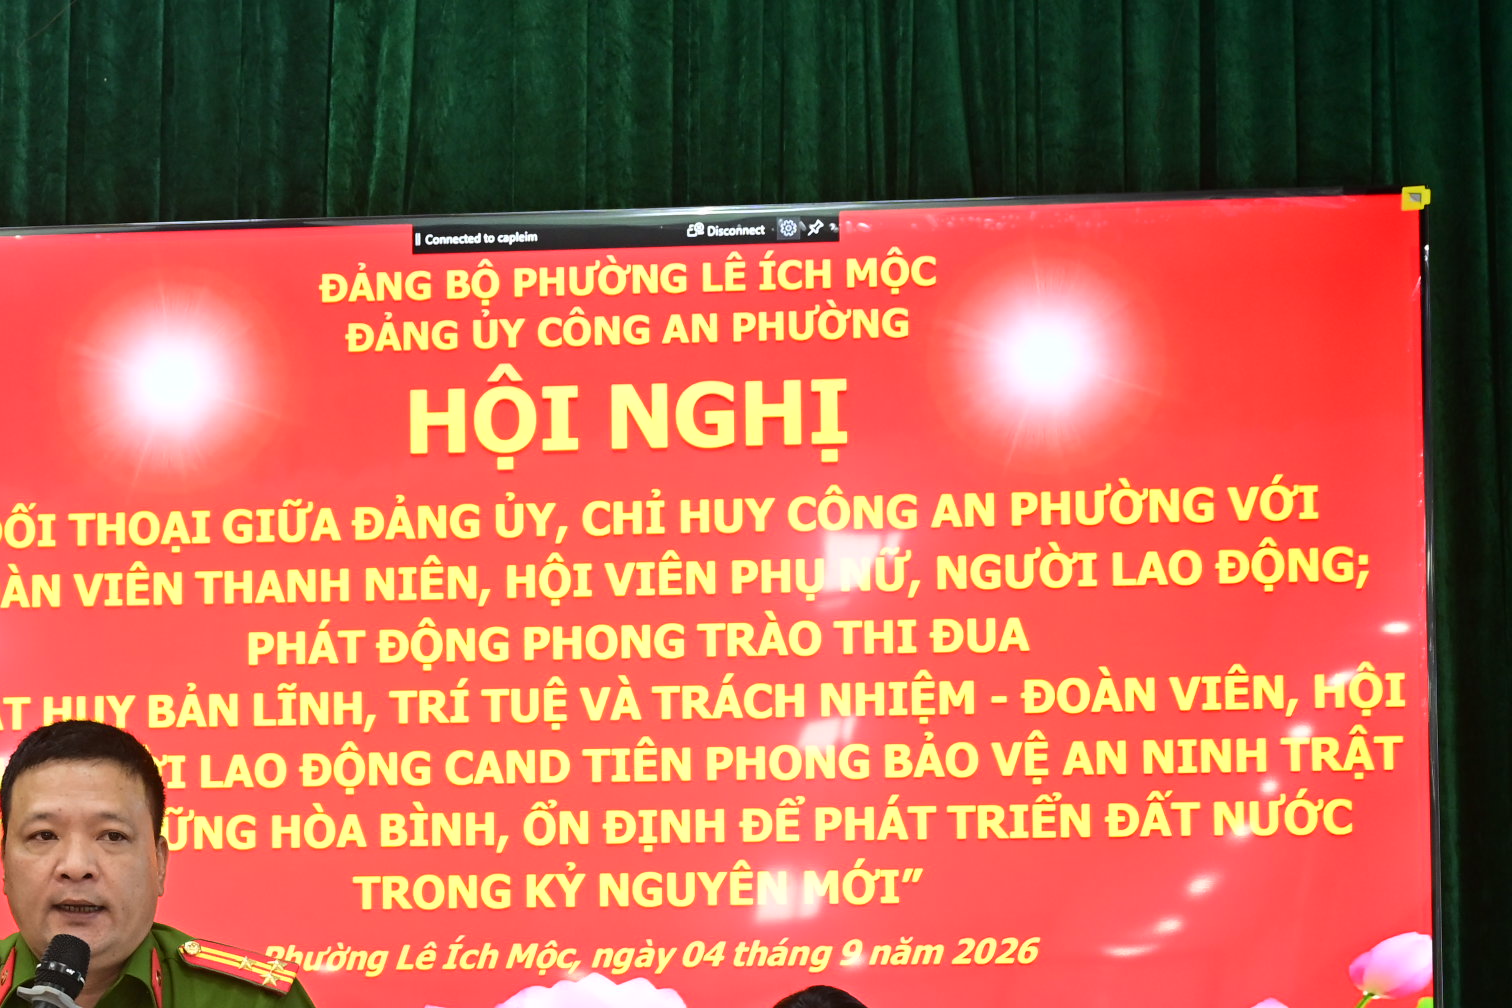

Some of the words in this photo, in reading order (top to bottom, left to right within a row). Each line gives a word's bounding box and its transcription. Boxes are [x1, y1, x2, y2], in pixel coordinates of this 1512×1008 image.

[424, 233, 482, 246] Connected
[483, 232, 496, 245] to
[496, 231, 539, 246] capleim
[706, 223, 766, 238] Disconnect
[319, 263, 431, 302] ĐẢNG
[447, 259, 499, 306] BỘ
[514, 255, 686, 297] PHƯỜNG
[703, 251, 746, 292] LÊ
[759, 250, 831, 290] ÍCH
[847, 247, 936, 294] MỘC
[345, 312, 458, 352] ĐẢNG
[473, 309, 525, 349] ỦY
[538, 307, 649, 347] CÔNG
[662, 313, 717, 343] AN
[733, 300, 908, 341] PHƯỜNG
[410, 364, 578, 470] HỘI
[611, 379, 847, 462] NGHỊ
[68, 511, 210, 553] THOẠI
[223, 499, 341, 543] GIỮA
[352, 495, 479, 540] ĐẢNG
[496, 492, 567, 544] ỦY,
[582, 489, 665, 536] CHỈ
[681, 498, 775, 533] HUY
[788, 485, 917, 531] CÔNG
[931, 493, 994, 528] AN
[1012, 478, 1214, 526] PHƯỜNG
[1228, 474, 1318, 521] VỚI
[74, 561, 182, 606] VIÊN
[195, 568, 349, 604] THANH
[366, 555, 490, 606] NIÊN,
[507, 552, 592, 606] HỘI
[604, 550, 716, 596] VIÊN
[732, 558, 825, 601] PHỤ
[839, 547, 920, 598] NỮ,
[937, 542, 1097, 589] NGƯỜI
[1113, 550, 1202, 586] LAO
[1215, 537, 1369, 591] ĐỘNG;
[248, 619, 366, 665] PHÁT
[376, 617, 509, 671] ĐỘNG
[524, 623, 684, 660] PHONG
[697, 611, 821, 657] TRÀO
[833, 619, 917, 654] THI
[930, 618, 1030, 653] ĐUA
[149, 683, 238, 728] BẢN
[254, 683, 376, 732] LĨNH,
[389, 678, 469, 724] TRÍ
[481, 676, 567, 730] TUỆ
[580, 675, 641, 721] VÀ
[652, 673, 804, 719] TRÁCH
[821, 670, 974, 724] NHIỆM
[1021, 666, 1155, 713] ĐOÀN
[1169, 664, 1298, 716] VIÊN,
[1315, 661, 1405, 716] HỘI
[201, 753, 287, 788] LAO
[299, 741, 430, 795] ĐỘNG
[445, 750, 570, 785] CAND
[582, 736, 691, 782] TIÊN
[707, 744, 869, 780] PHONG
[885, 732, 978, 778] BẢO
[991, 730, 1048, 784] VỆ
[1063, 741, 1126, 775] AN
[1143, 738, 1266, 774] NINH
[1280, 725, 1403, 779] TRẬT
[158, 806, 257, 851] ỮNG
[272, 803, 367, 848] HÒA
[381, 801, 508, 853] BÌNH,
[524, 800, 588, 846] ỔN
[602, 809, 725, 852] ĐỊNH
[739, 796, 805, 842] ĐỂ
[815, 794, 936, 841] PHÁT
[947, 792, 1090, 839] TRIỂN
[1105, 790, 1200, 837] ĐẤT
[1214, 788, 1352, 836] NƯỚC
[353, 874, 510, 910] TRONG
[527, 862, 585, 907] KỶ
[600, 860, 788, 907] NGUYÊN
[804, 858, 923, 905] MỚI”
[395, 942, 437, 971] Lê
[442, 935, 499, 971] Ích
[505, 939, 581, 977] Mộc,
[591, 938, 676, 975] ngày
[681, 940, 725, 968] 04
[732, 937, 833, 973] tháng
[839, 938, 864, 968] 9
[868, 936, 945, 967] năm
[951, 936, 1041, 965] 2026
